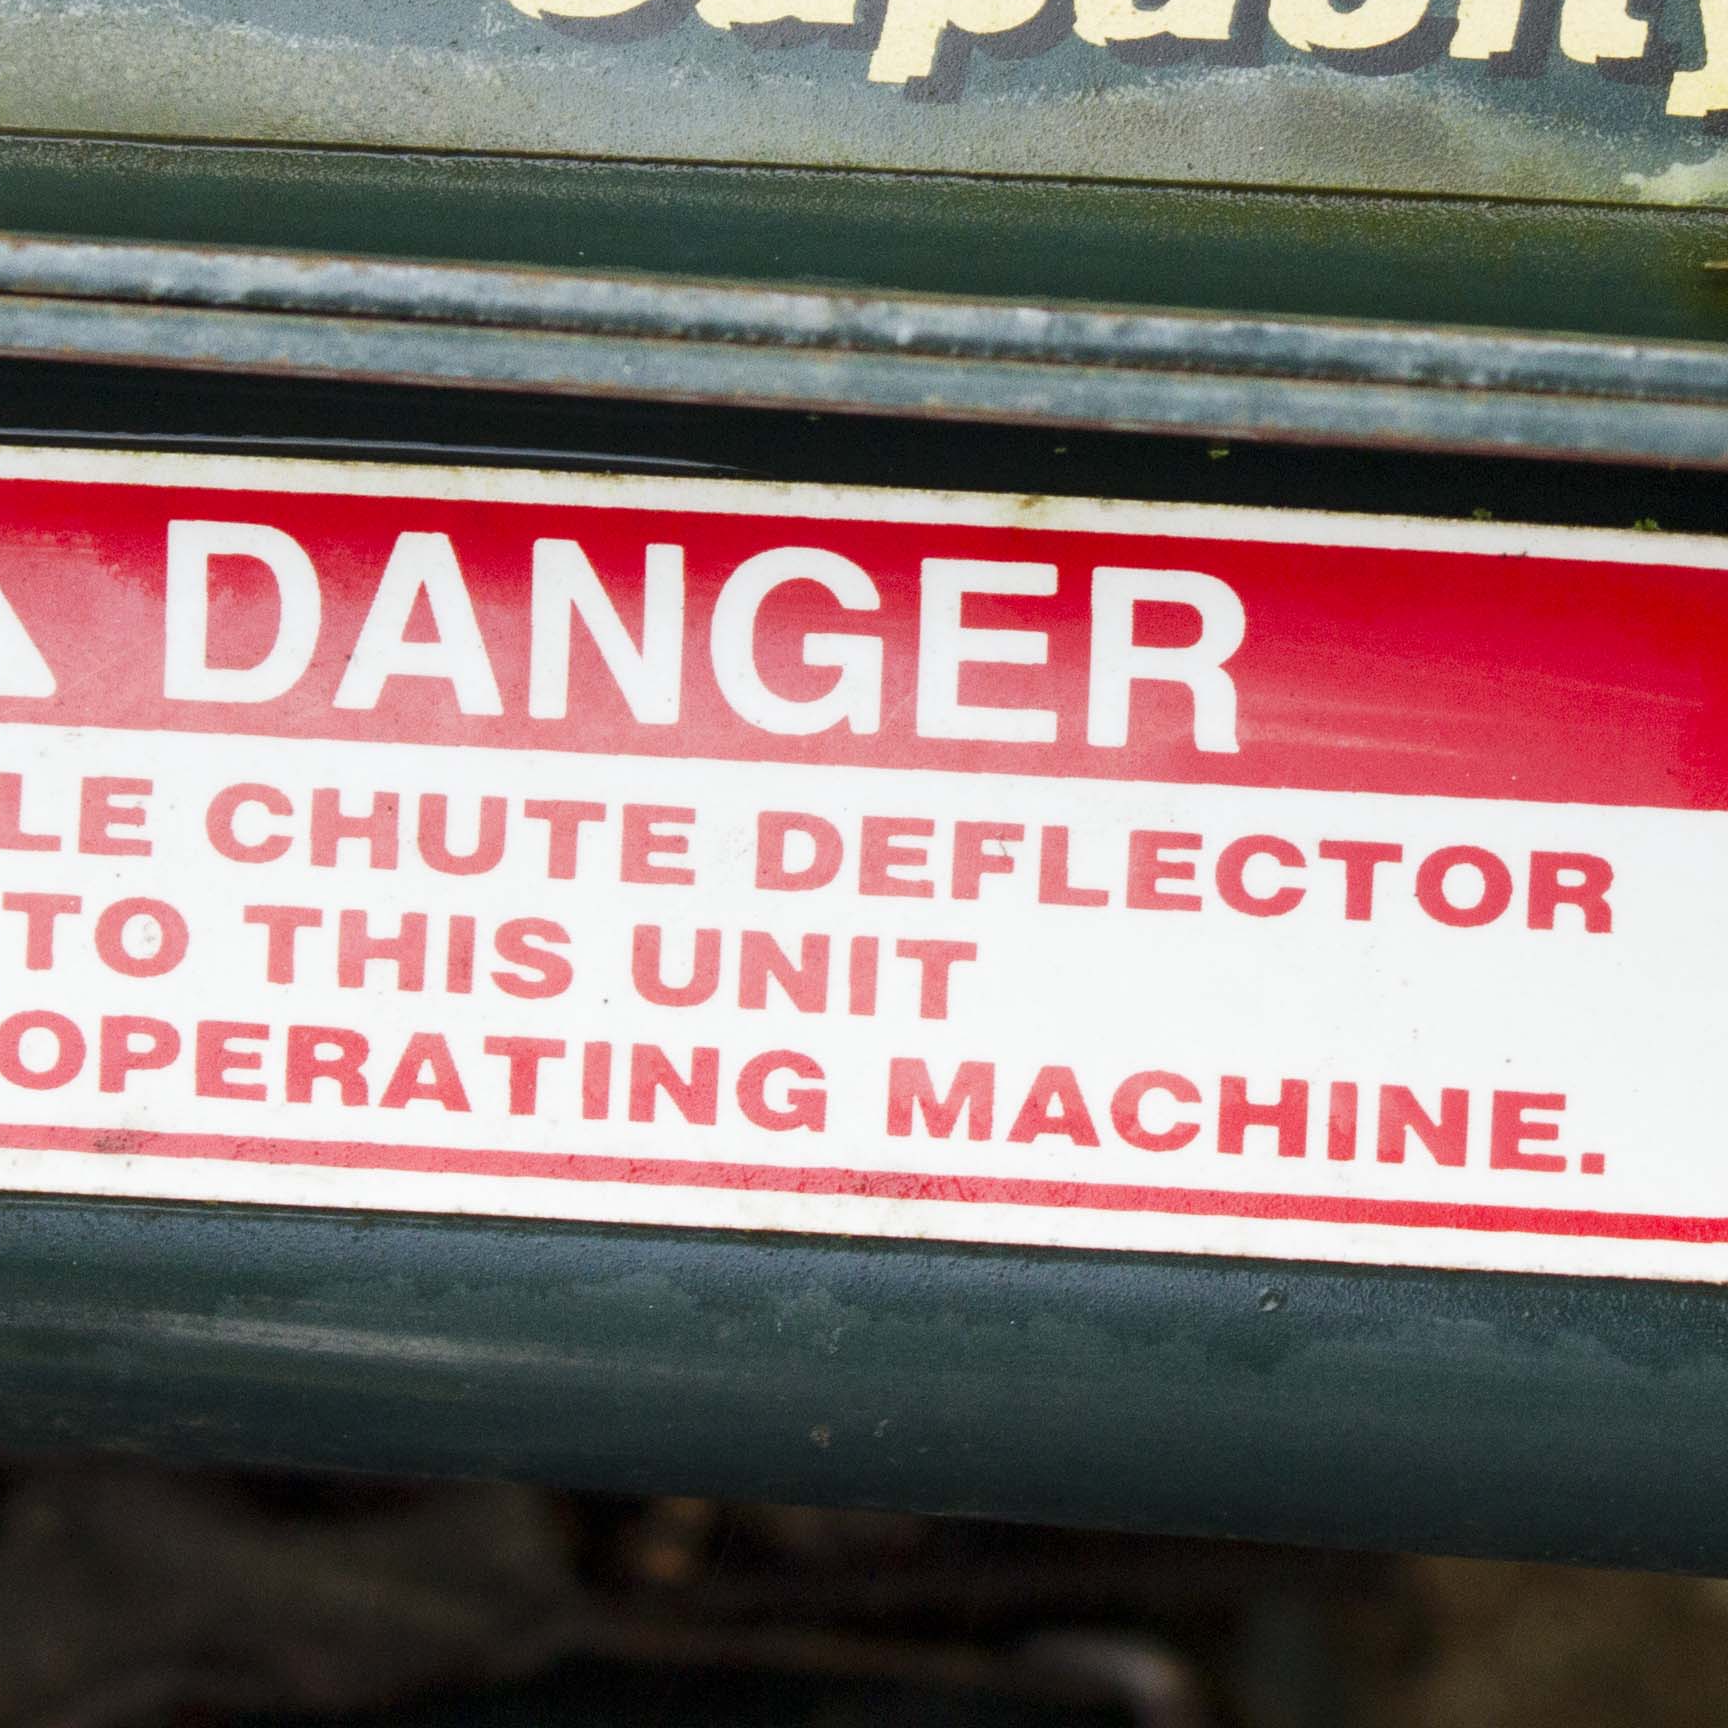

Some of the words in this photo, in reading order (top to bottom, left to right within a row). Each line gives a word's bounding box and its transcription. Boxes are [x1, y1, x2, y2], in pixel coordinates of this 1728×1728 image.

[163, 518, 1249, 755] DANGER
[206, 782, 696, 887] CHUTE
[754, 809, 1615, 935] DEFLECTOR
[2, 891, 190, 979] TO
[243, 904, 574, 1001] THIS
[631, 924, 978, 1021] UNIT
[885, 1056, 1607, 1175] MACHINE.
